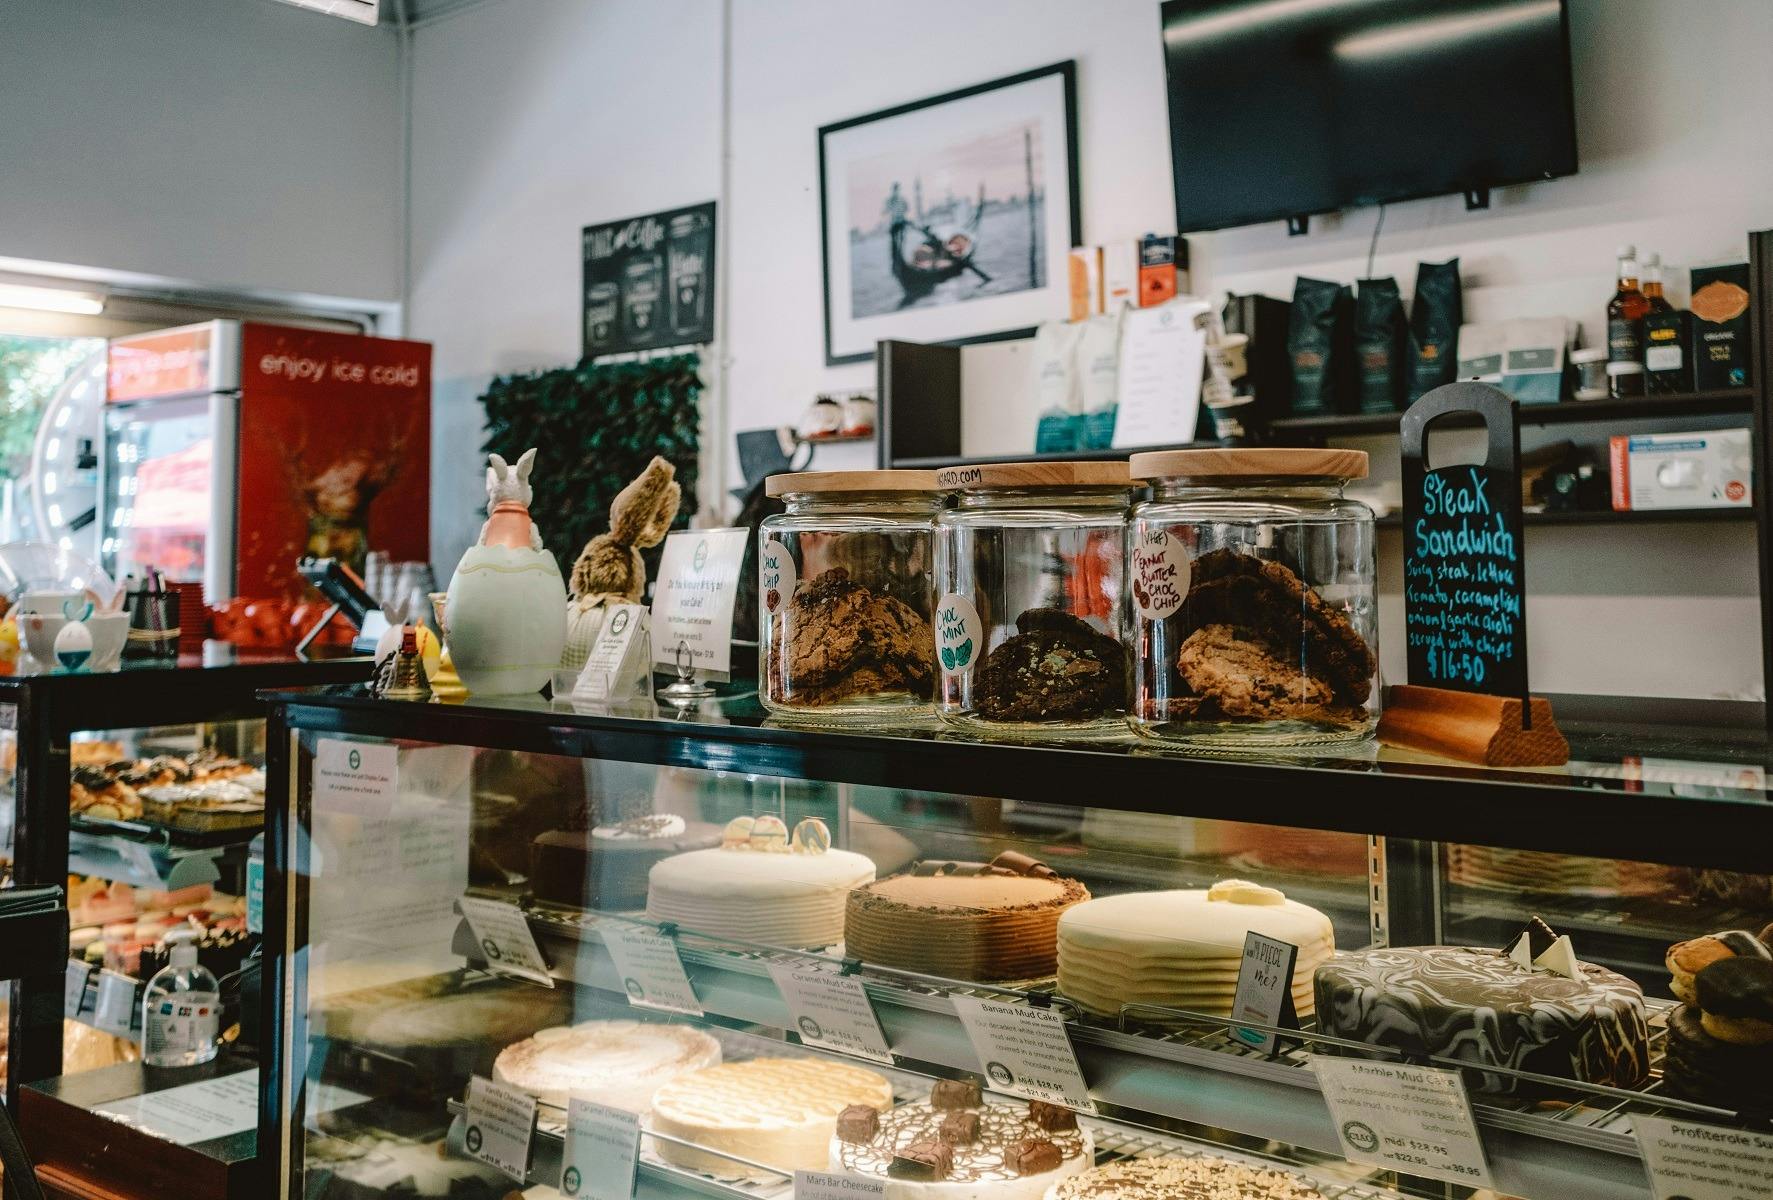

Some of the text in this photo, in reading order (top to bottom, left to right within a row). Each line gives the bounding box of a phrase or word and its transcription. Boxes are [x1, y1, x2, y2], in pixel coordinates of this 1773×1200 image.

[259, 354, 418, 387] enjoy ice cold
[1424, 468, 1490, 517] Steak
[1416, 512, 1516, 561] Sandwich
[1134, 549, 1166, 570] PEANUT
[764, 572, 780, 589] CHIP
[1141, 564, 1177, 587] BUTTER
[1149, 583, 1176, 596] CHOC
[1154, 594, 1180, 610] CHIP
[937, 607, 958, 630] CHOC
[1448, 612, 1480, 632] garlic
[943, 618, 964, 644] MINT
[1448, 628, 1474, 648] with
[1476, 635, 1512, 662] chips
[1260, 943, 1284, 968] PIECE
[792, 972, 860, 991] Caramel Mud Cake
[1254, 969, 1278, 990] me?
[981, 1003, 1059, 1022] Banana Mud Cake
[993, 1070, 1010, 1080] CIAO
[1018, 1076, 1064, 1092] Midi $28.95
[1352, 1064, 1393, 1078] Marble
[1396, 1070, 1424, 1084] Mud
[1026, 1088, 1050, 1100] $21.95
[1350, 1132, 1374, 1143] CIAO
[1671, 1124, 1750, 1146] Profiterole
[1384, 1136, 1406, 1147] midi
[1409, 1140, 1448, 1156] $28.95
[1658, 1140, 1677, 1149] Our
[1712, 1148, 1764, 1162] chocolate
[1394, 1152, 1428, 1166] $22.95
[806, 1175, 884, 1194] Mars Bar Cheesecake
